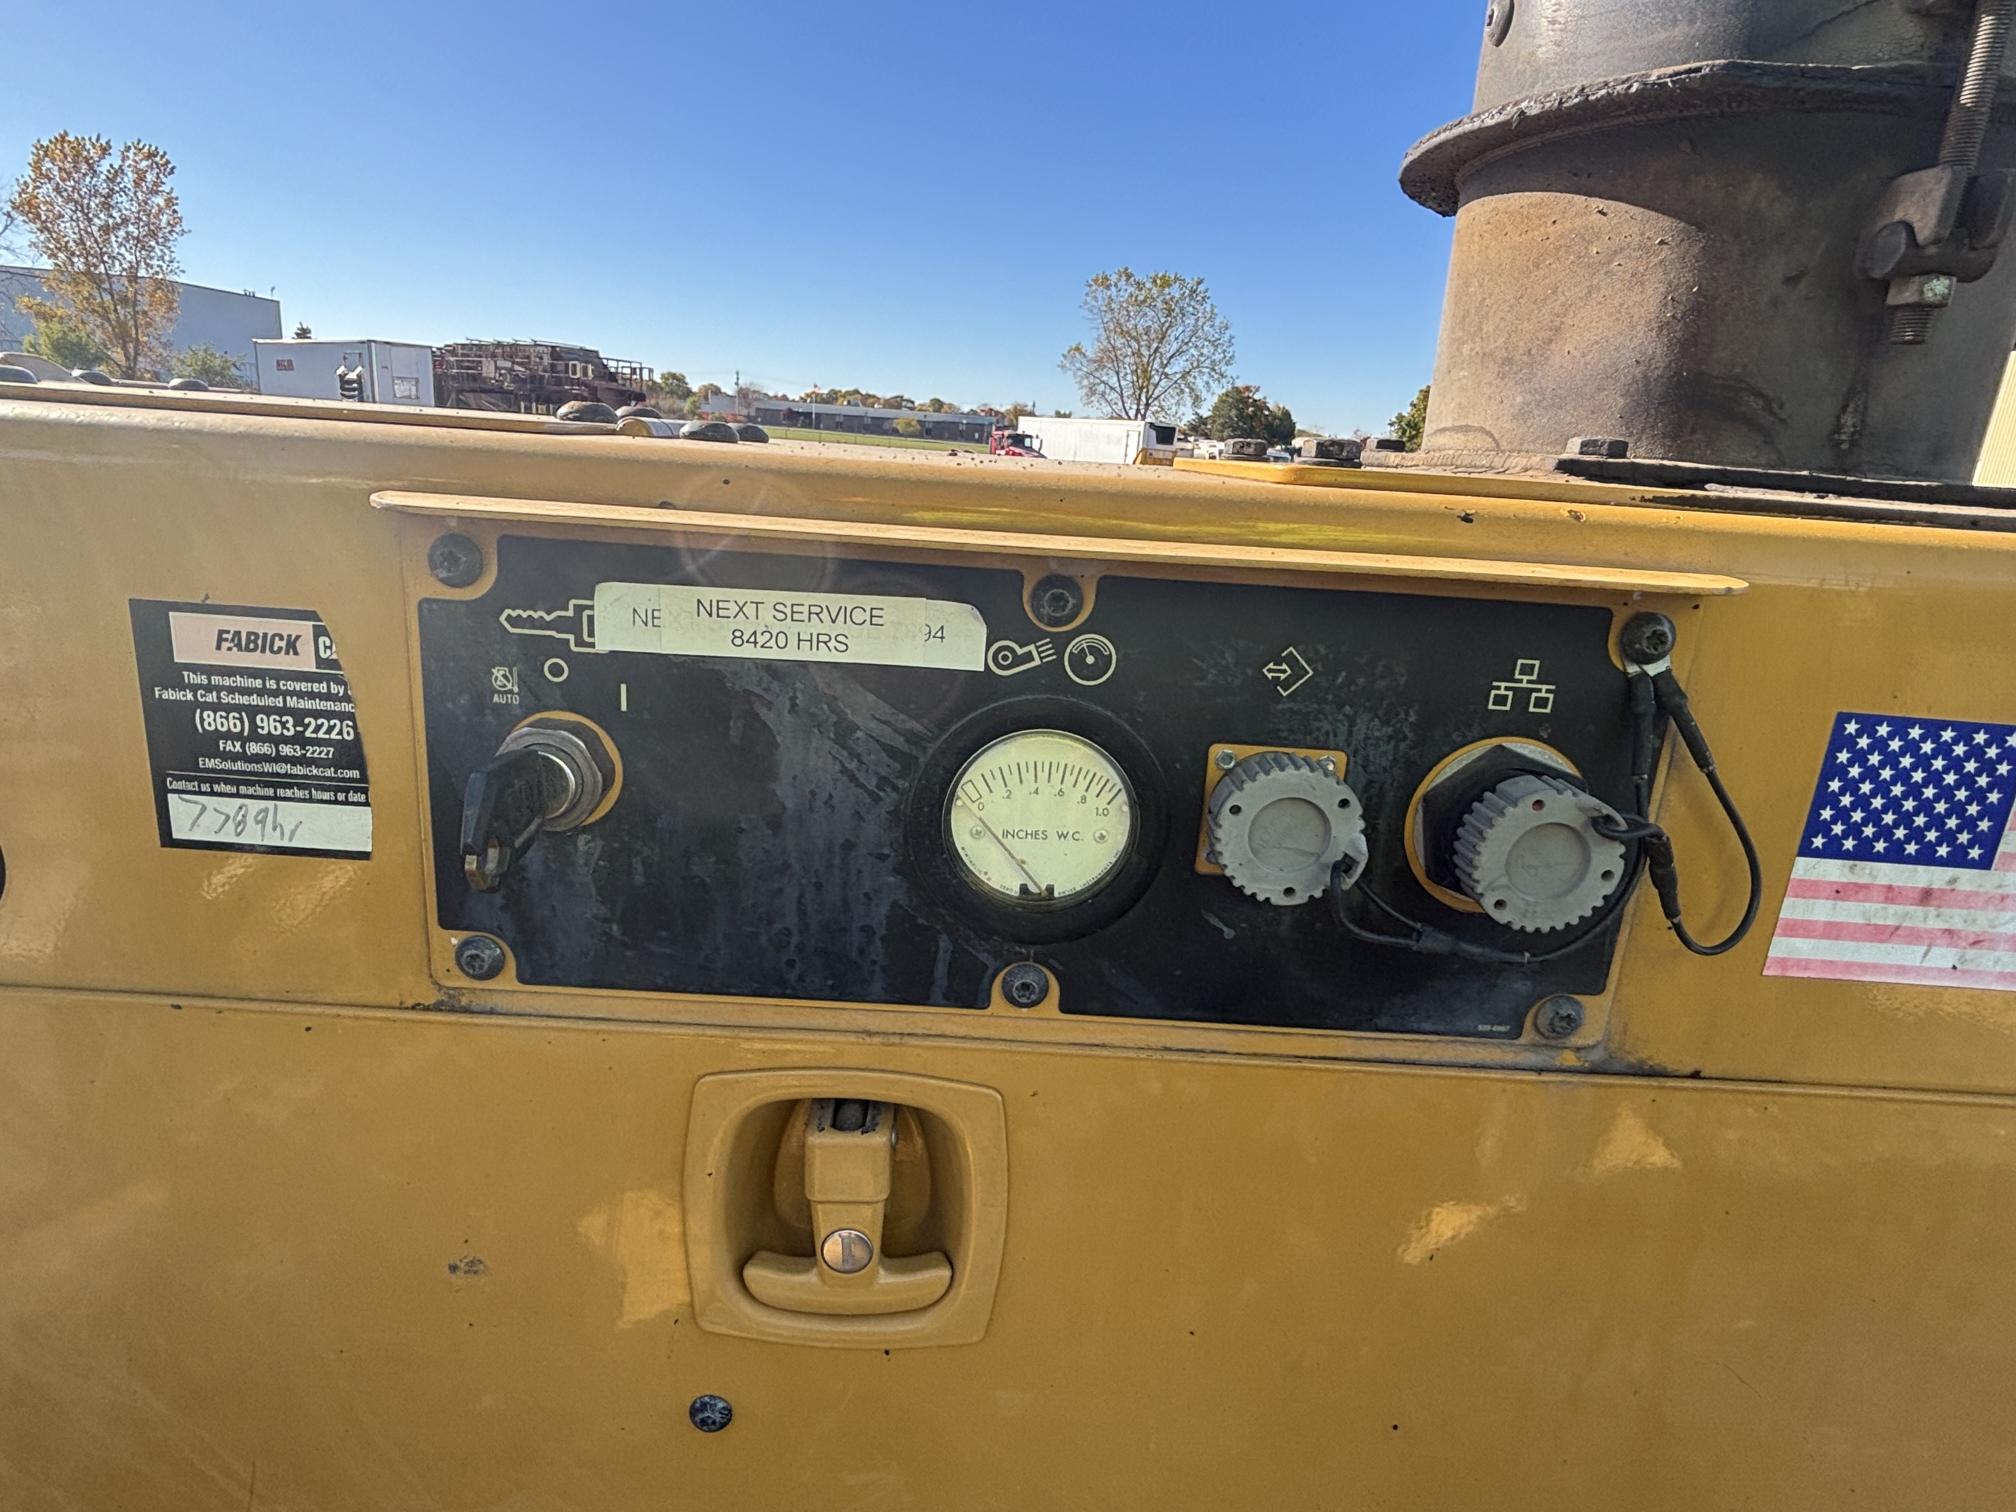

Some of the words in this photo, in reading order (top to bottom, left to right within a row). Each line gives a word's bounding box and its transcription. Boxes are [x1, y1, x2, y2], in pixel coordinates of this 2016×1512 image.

[697, 599, 764, 620] NEXT
[773, 602, 885, 626] SERVICE
[215, 629, 302, 656] FABICK
[731, 629, 789, 649] 8420
[797, 632, 849, 653] HRS
[182, 671, 208, 685] This
[211, 675, 263, 689] machine
[266, 677, 277, 689] is
[280, 680, 327, 693] covered
[330, 682, 345, 697] by
[154, 687, 194, 701] Fabick
[197, 690, 217, 703] Cat
[220, 691, 283, 707] Scheduled
[493, 694, 519, 704] AUTO
[195, 708, 249, 736] (866)
[256, 714, 354, 740] 963-2226
[219, 740, 242, 752] FAX
[246, 742, 276, 757] (866)
[279, 745, 334, 758] 963-2227
[199, 757, 360, 779] EMSolutionsWI@fabickcat.com
[166, 777, 199, 792] Contact
[201, 783, 211, 792] us
[213, 781, 237, 793] when
[239, 784, 274, 797] machine
[277, 786, 310, 799] reaches
[312, 787, 335, 801] hours
[337, 793, 346, 801] or
[348, 790, 367, 802] date
[1095, 806, 1110, 817] 1.0
[1002, 828, 1048, 840] INCHES
